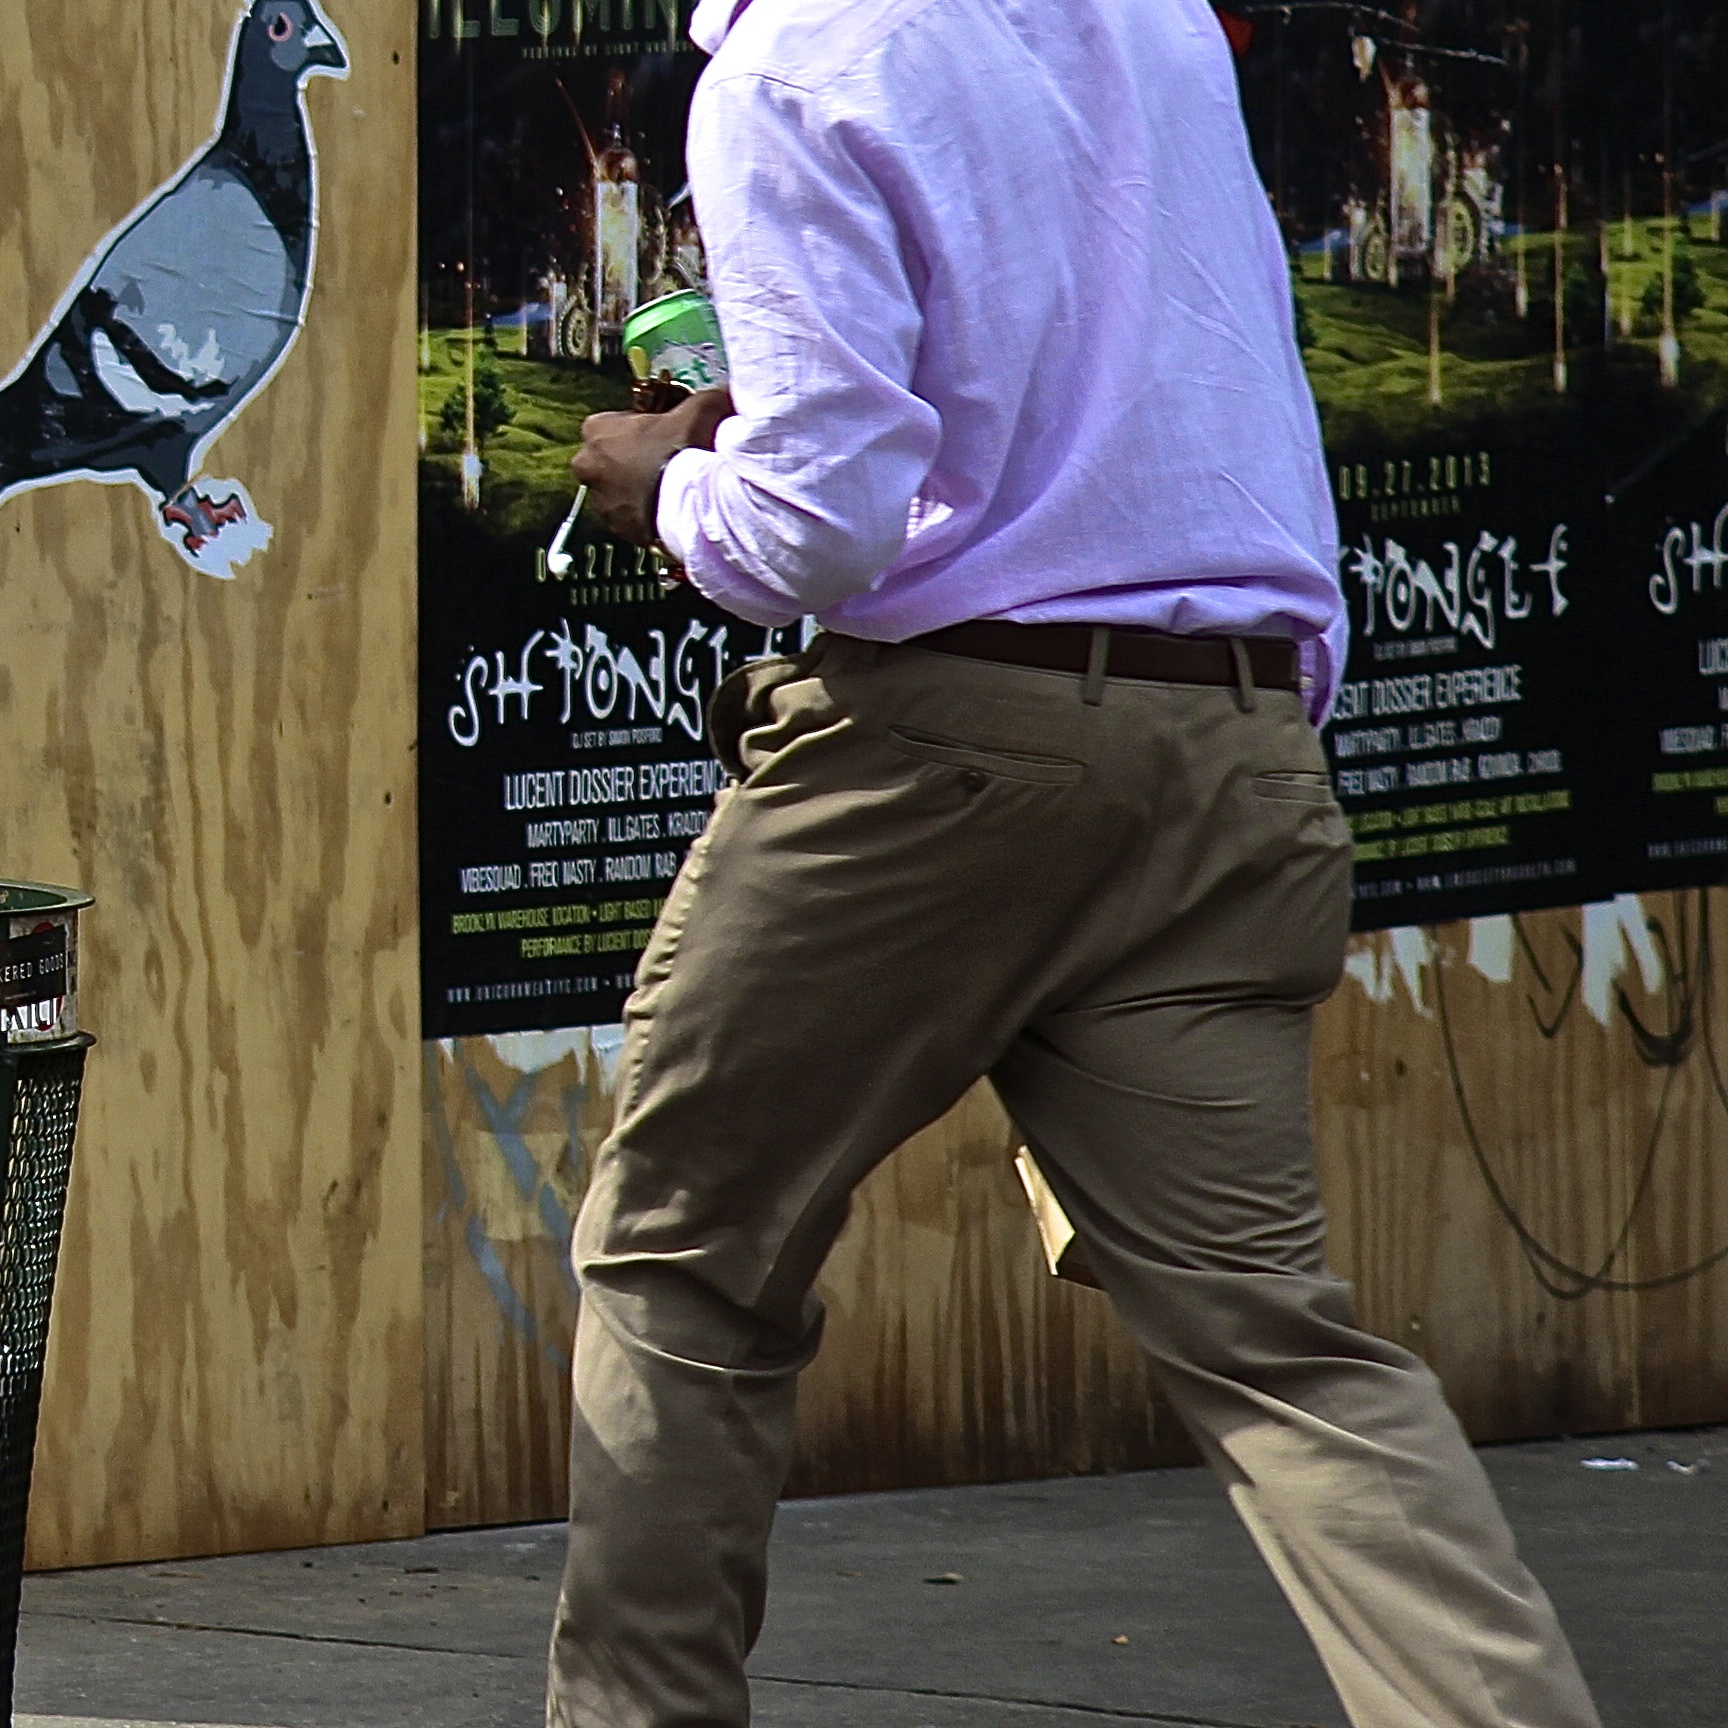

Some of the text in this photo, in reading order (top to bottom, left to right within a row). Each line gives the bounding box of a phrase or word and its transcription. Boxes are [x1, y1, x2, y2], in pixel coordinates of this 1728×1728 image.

[1338, 450, 1492, 501] 09.27.2013
[503, 771, 565, 811] LUCENT
[568, 766, 635, 807] DOSSIER
[526, 817, 600, 849] MARTYPARTY
[459, 863, 522, 895] VIBESQUAD
[563, 857, 597, 886] NASTY
